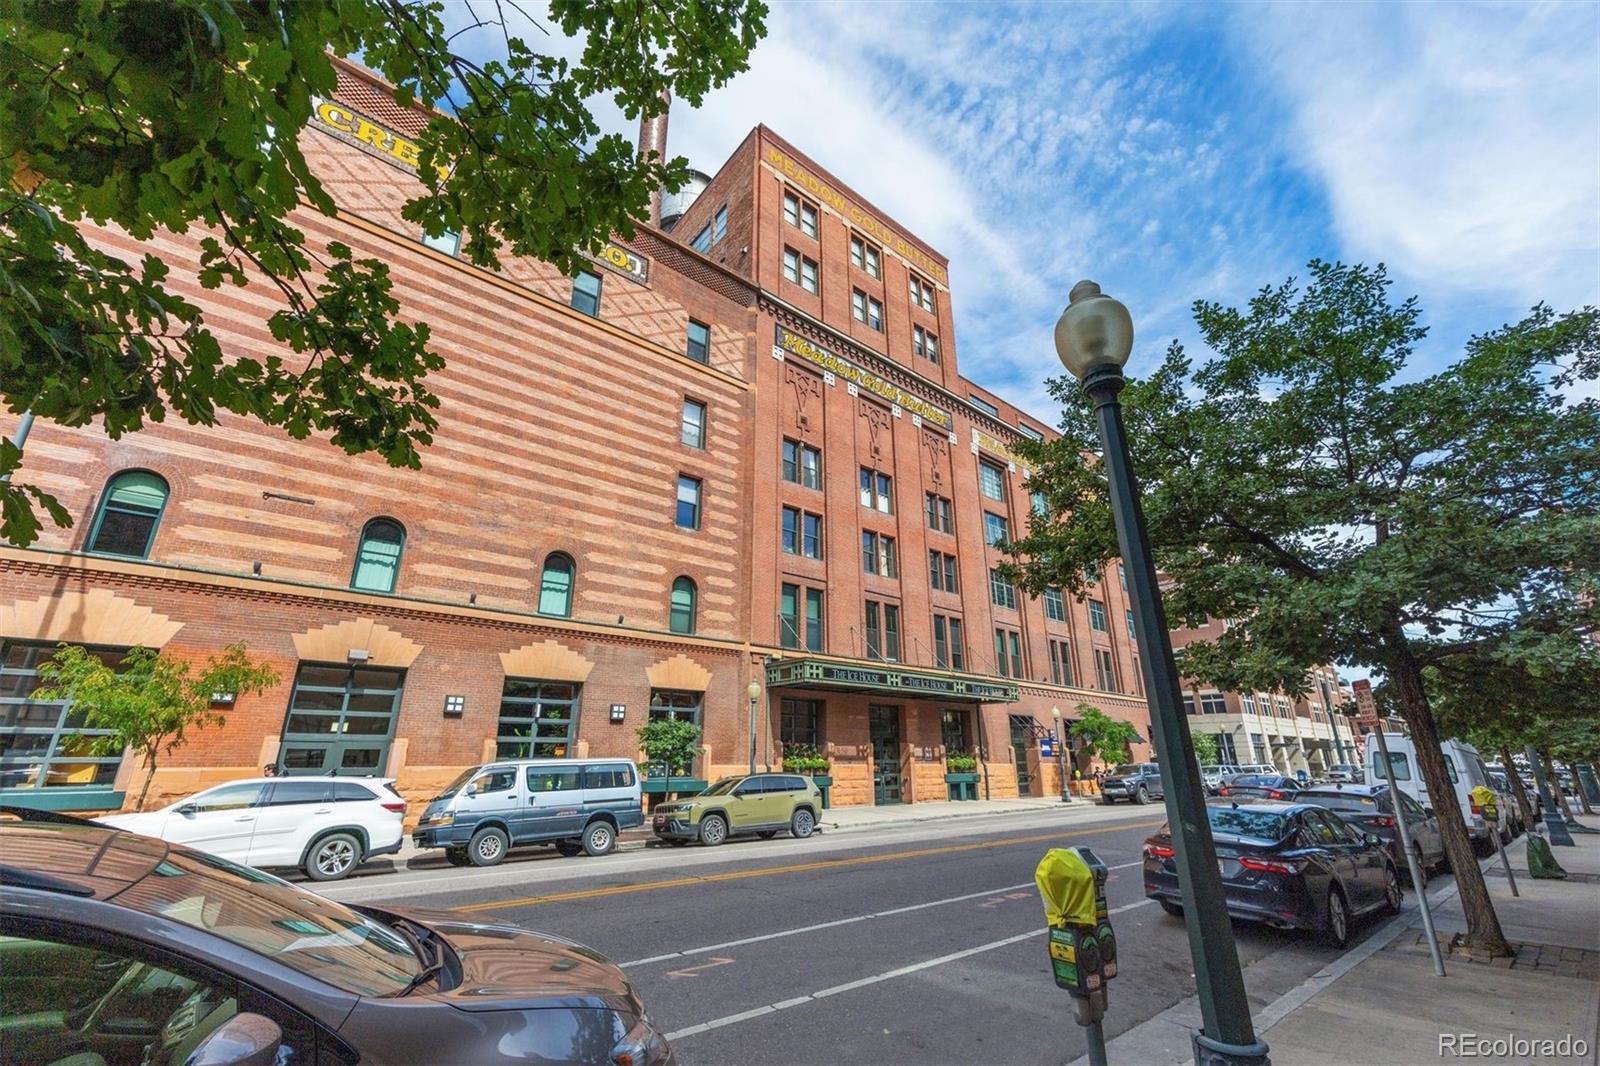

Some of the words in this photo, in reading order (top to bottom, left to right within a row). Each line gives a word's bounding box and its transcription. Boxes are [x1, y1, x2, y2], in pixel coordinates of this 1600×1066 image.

[768, 148, 846, 212] MEADOW
[849, 206, 892, 244] GOLD
[897, 236, 946, 279] BUTTER
[782, 329, 860, 382] Meadow
[863, 375, 898, 400] Gold
[899, 391, 950, 426] Butter
[832, 668, 848, 680] THE
[859, 671, 880, 683] HOUSE
[930, 680, 948, 690] HOUSE
